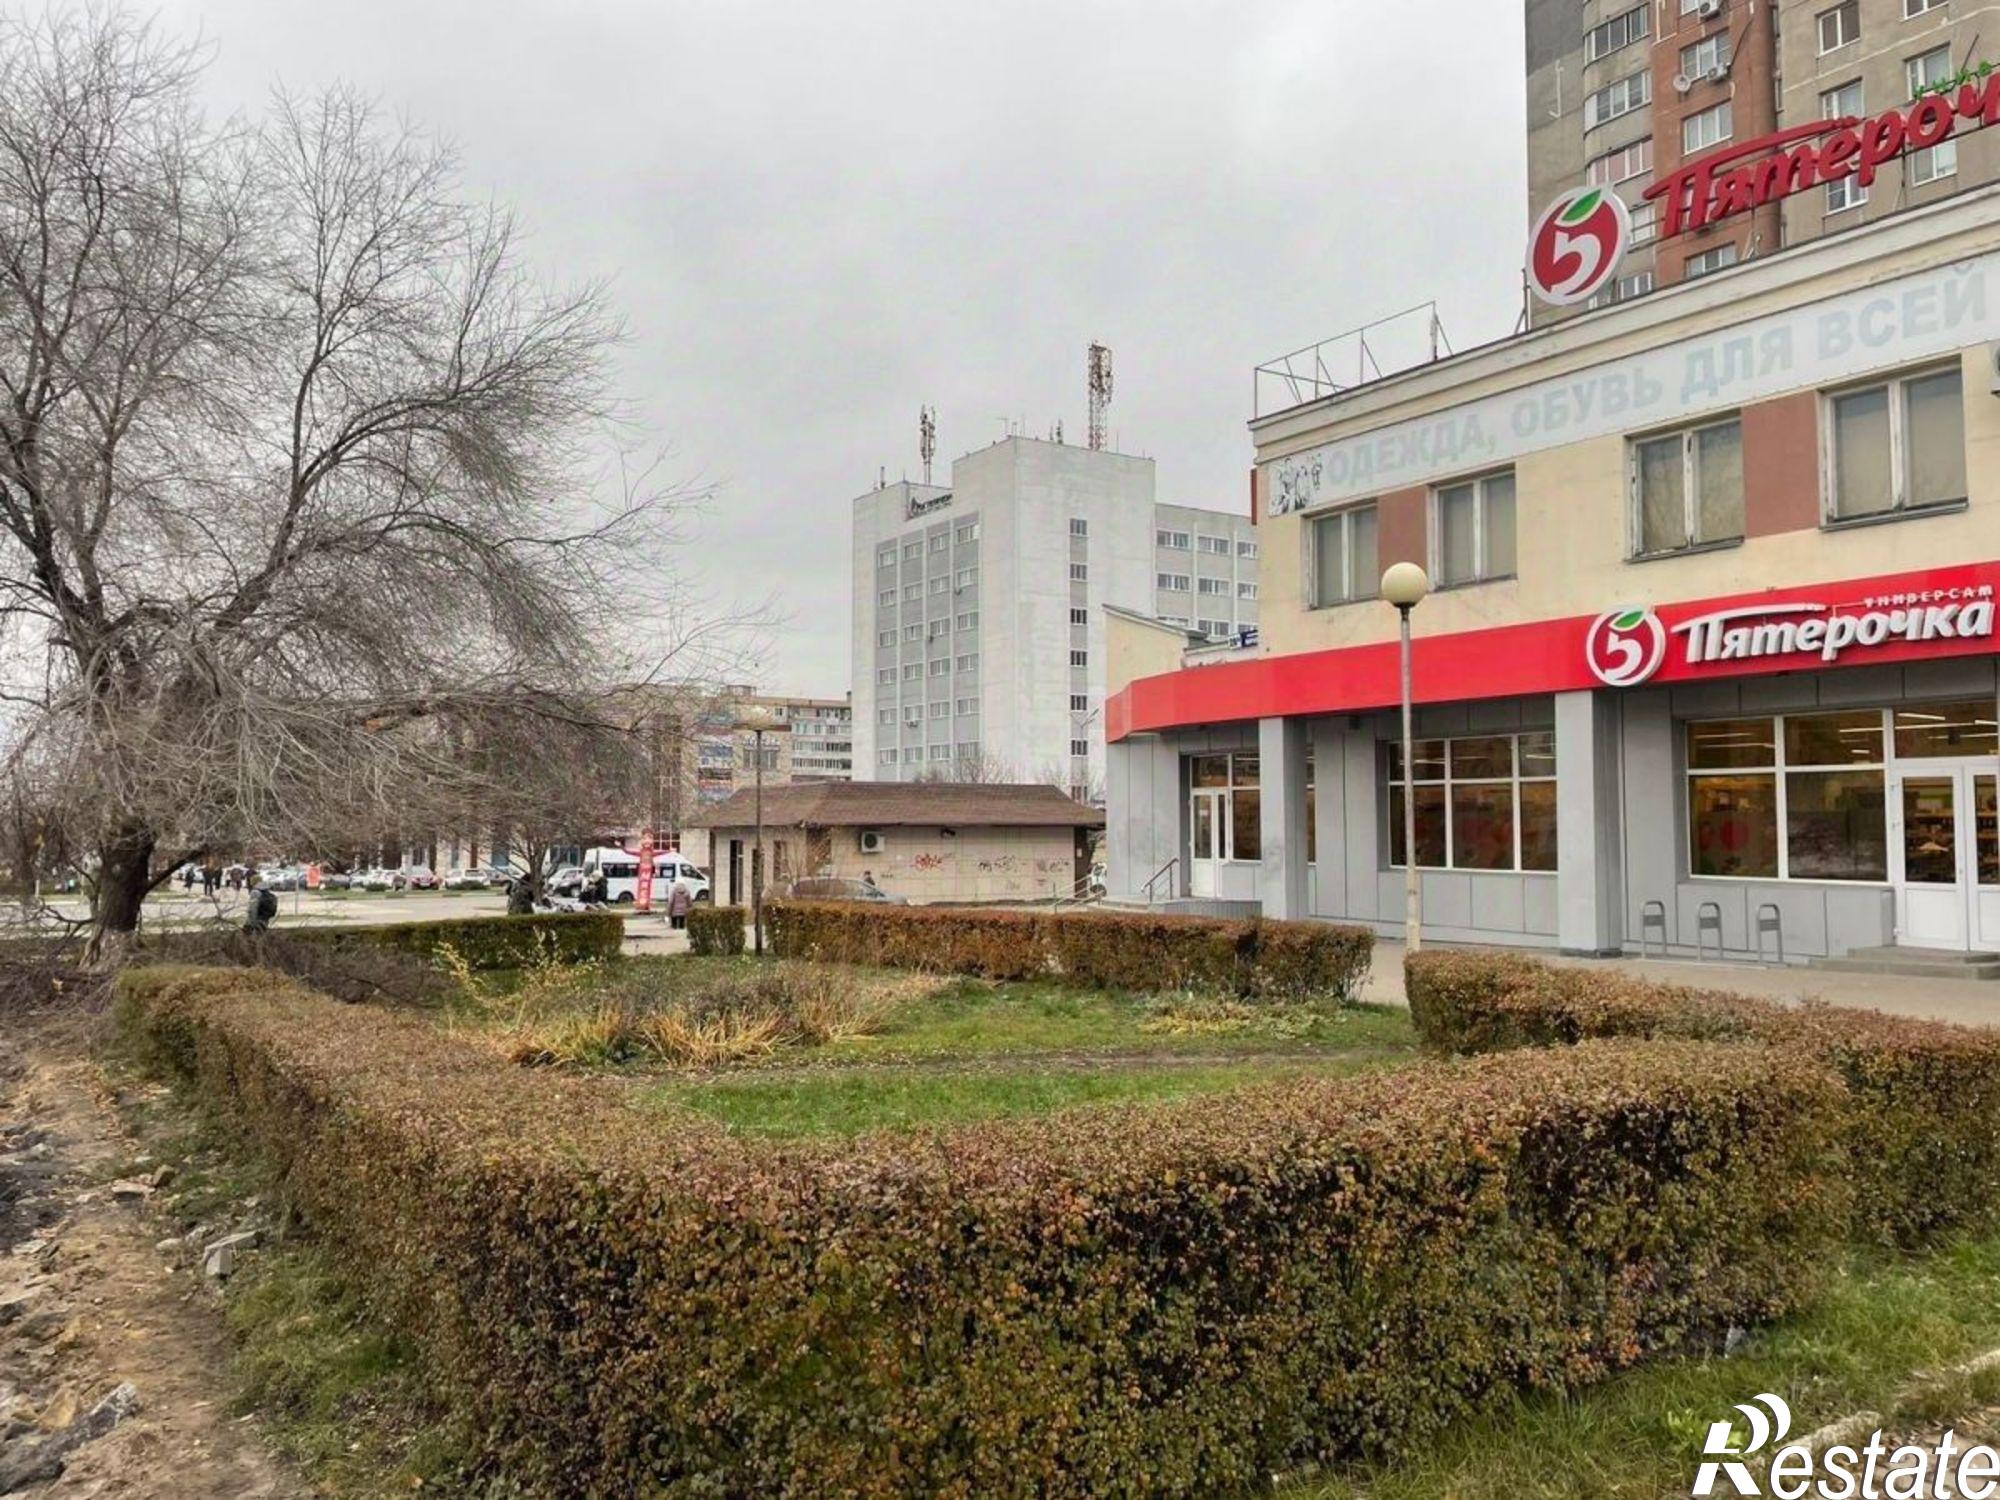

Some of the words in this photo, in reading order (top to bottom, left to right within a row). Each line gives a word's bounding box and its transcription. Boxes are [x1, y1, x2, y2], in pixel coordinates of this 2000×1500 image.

[1326, 414, 1496, 487] ОДЕЖДА,
[1511, 368, 1662, 438] ОБУВЬ
[1680, 325, 1793, 404] ДЛЯ
[1817, 264, 1986, 361] ВСЕЙ
[1671, 601, 1995, 663] Пятерочка
